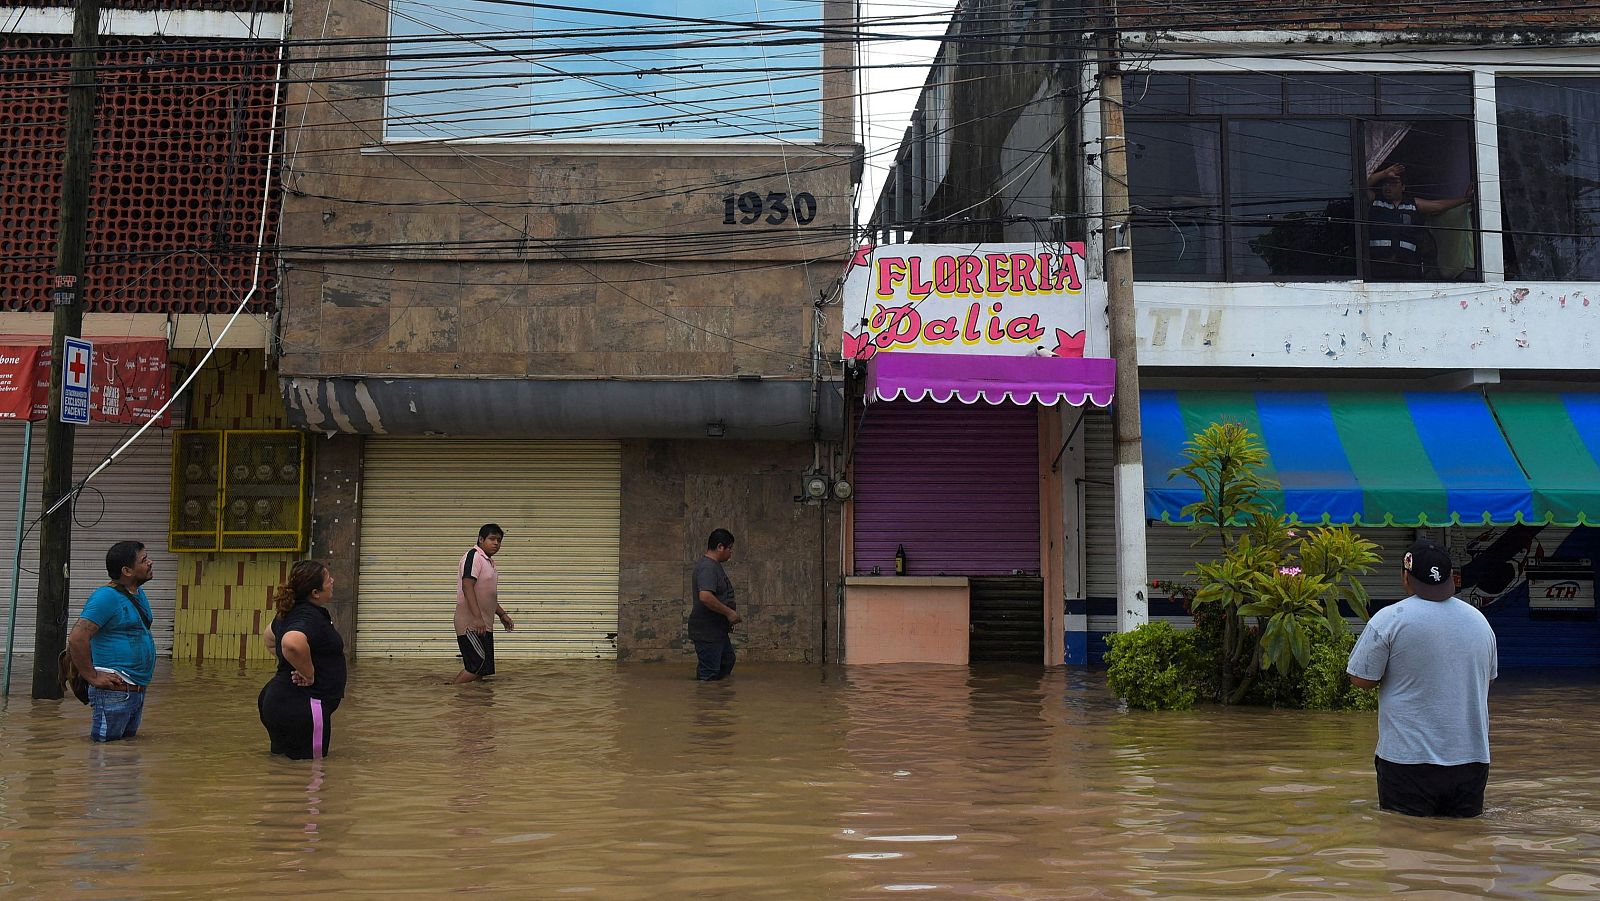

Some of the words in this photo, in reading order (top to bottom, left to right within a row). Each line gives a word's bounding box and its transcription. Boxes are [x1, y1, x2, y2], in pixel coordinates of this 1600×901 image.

[722, 191, 817, 225] 1930
[876, 253, 1082, 298] FLORERIA
[871, 302, 1046, 349] Dalia
[1137, 307, 1223, 347] TH
[64, 396, 87, 408] EXCLUSIVO
[64, 406, 87, 417] PACIENTE
[1546, 587, 1577, 599] LTH
